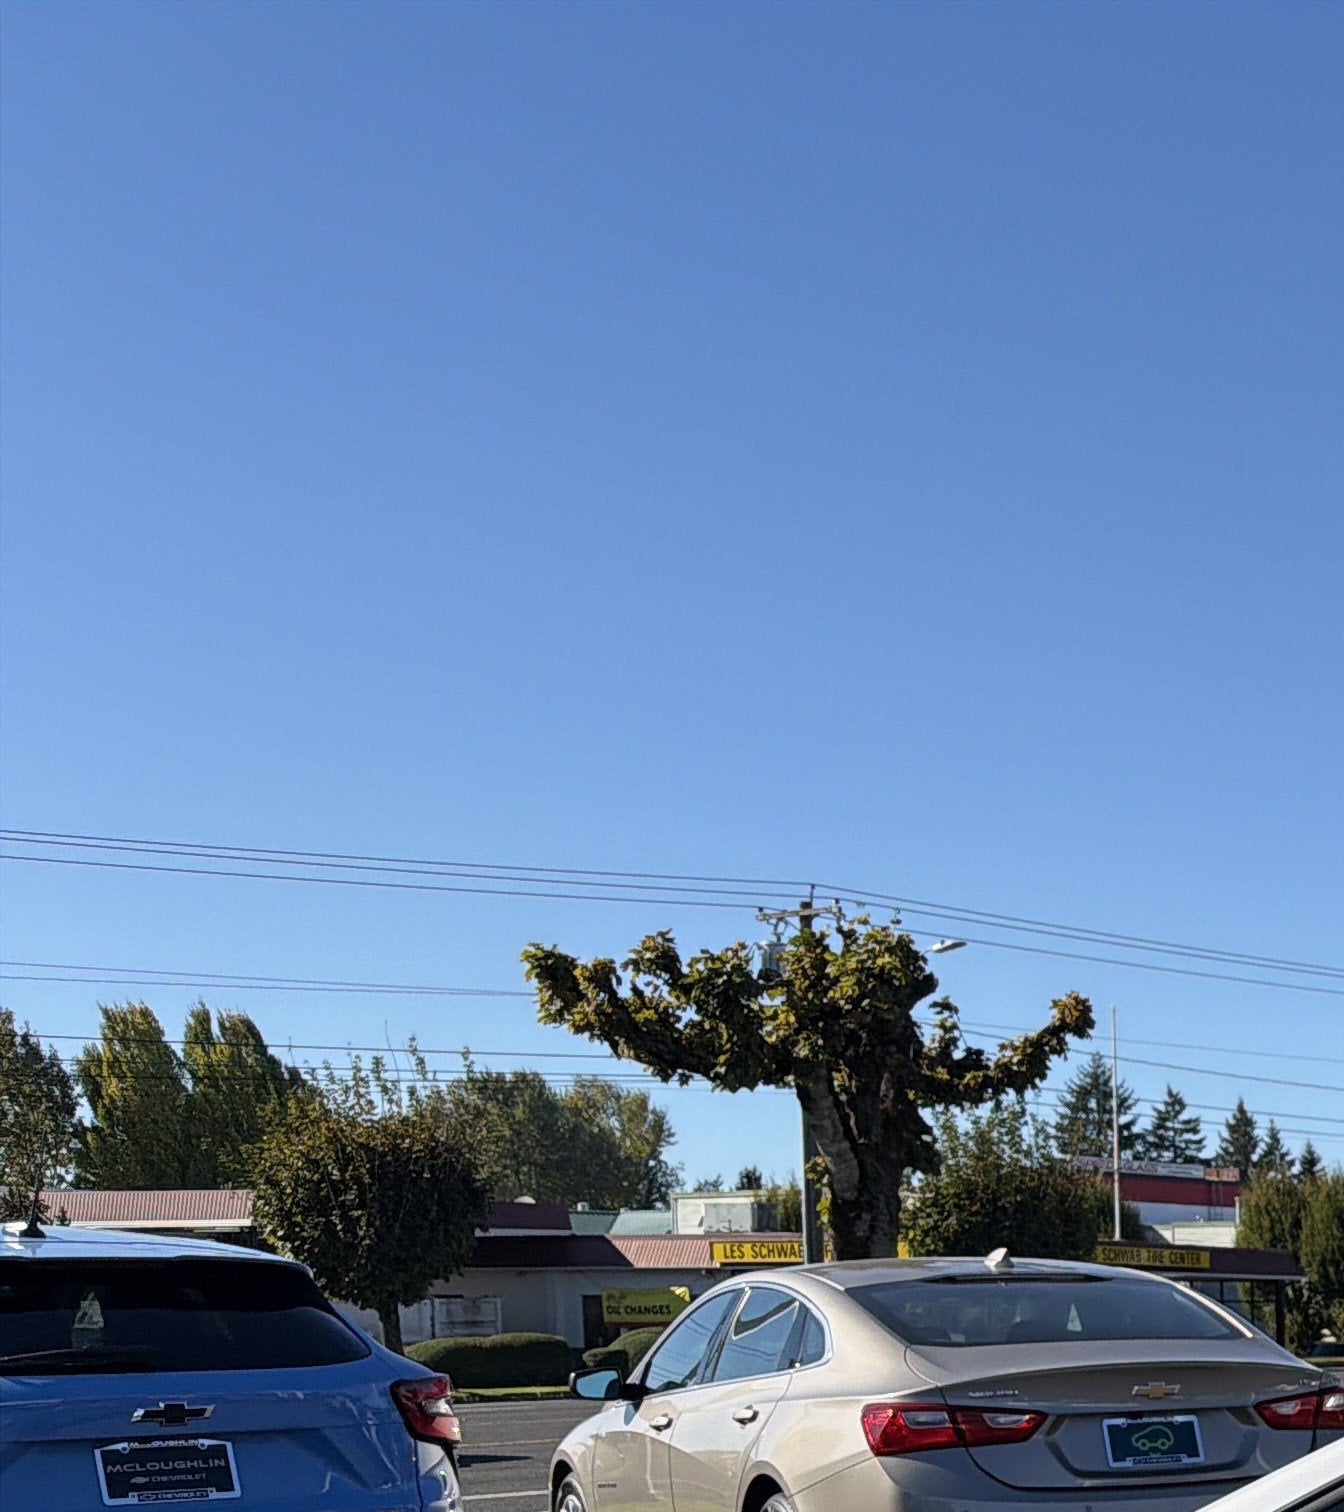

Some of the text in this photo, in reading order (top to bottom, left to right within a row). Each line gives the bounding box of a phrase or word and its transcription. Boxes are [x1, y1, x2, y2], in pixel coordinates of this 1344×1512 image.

[723, 1243, 746, 1260] LES
[1101, 1246, 1142, 1262] SCHWAB
[1169, 1250, 1201, 1266] CENTER
[606, 1303, 672, 1315] OIL CHANGES
[106, 1458, 226, 1474] MCLOUGHLIN
